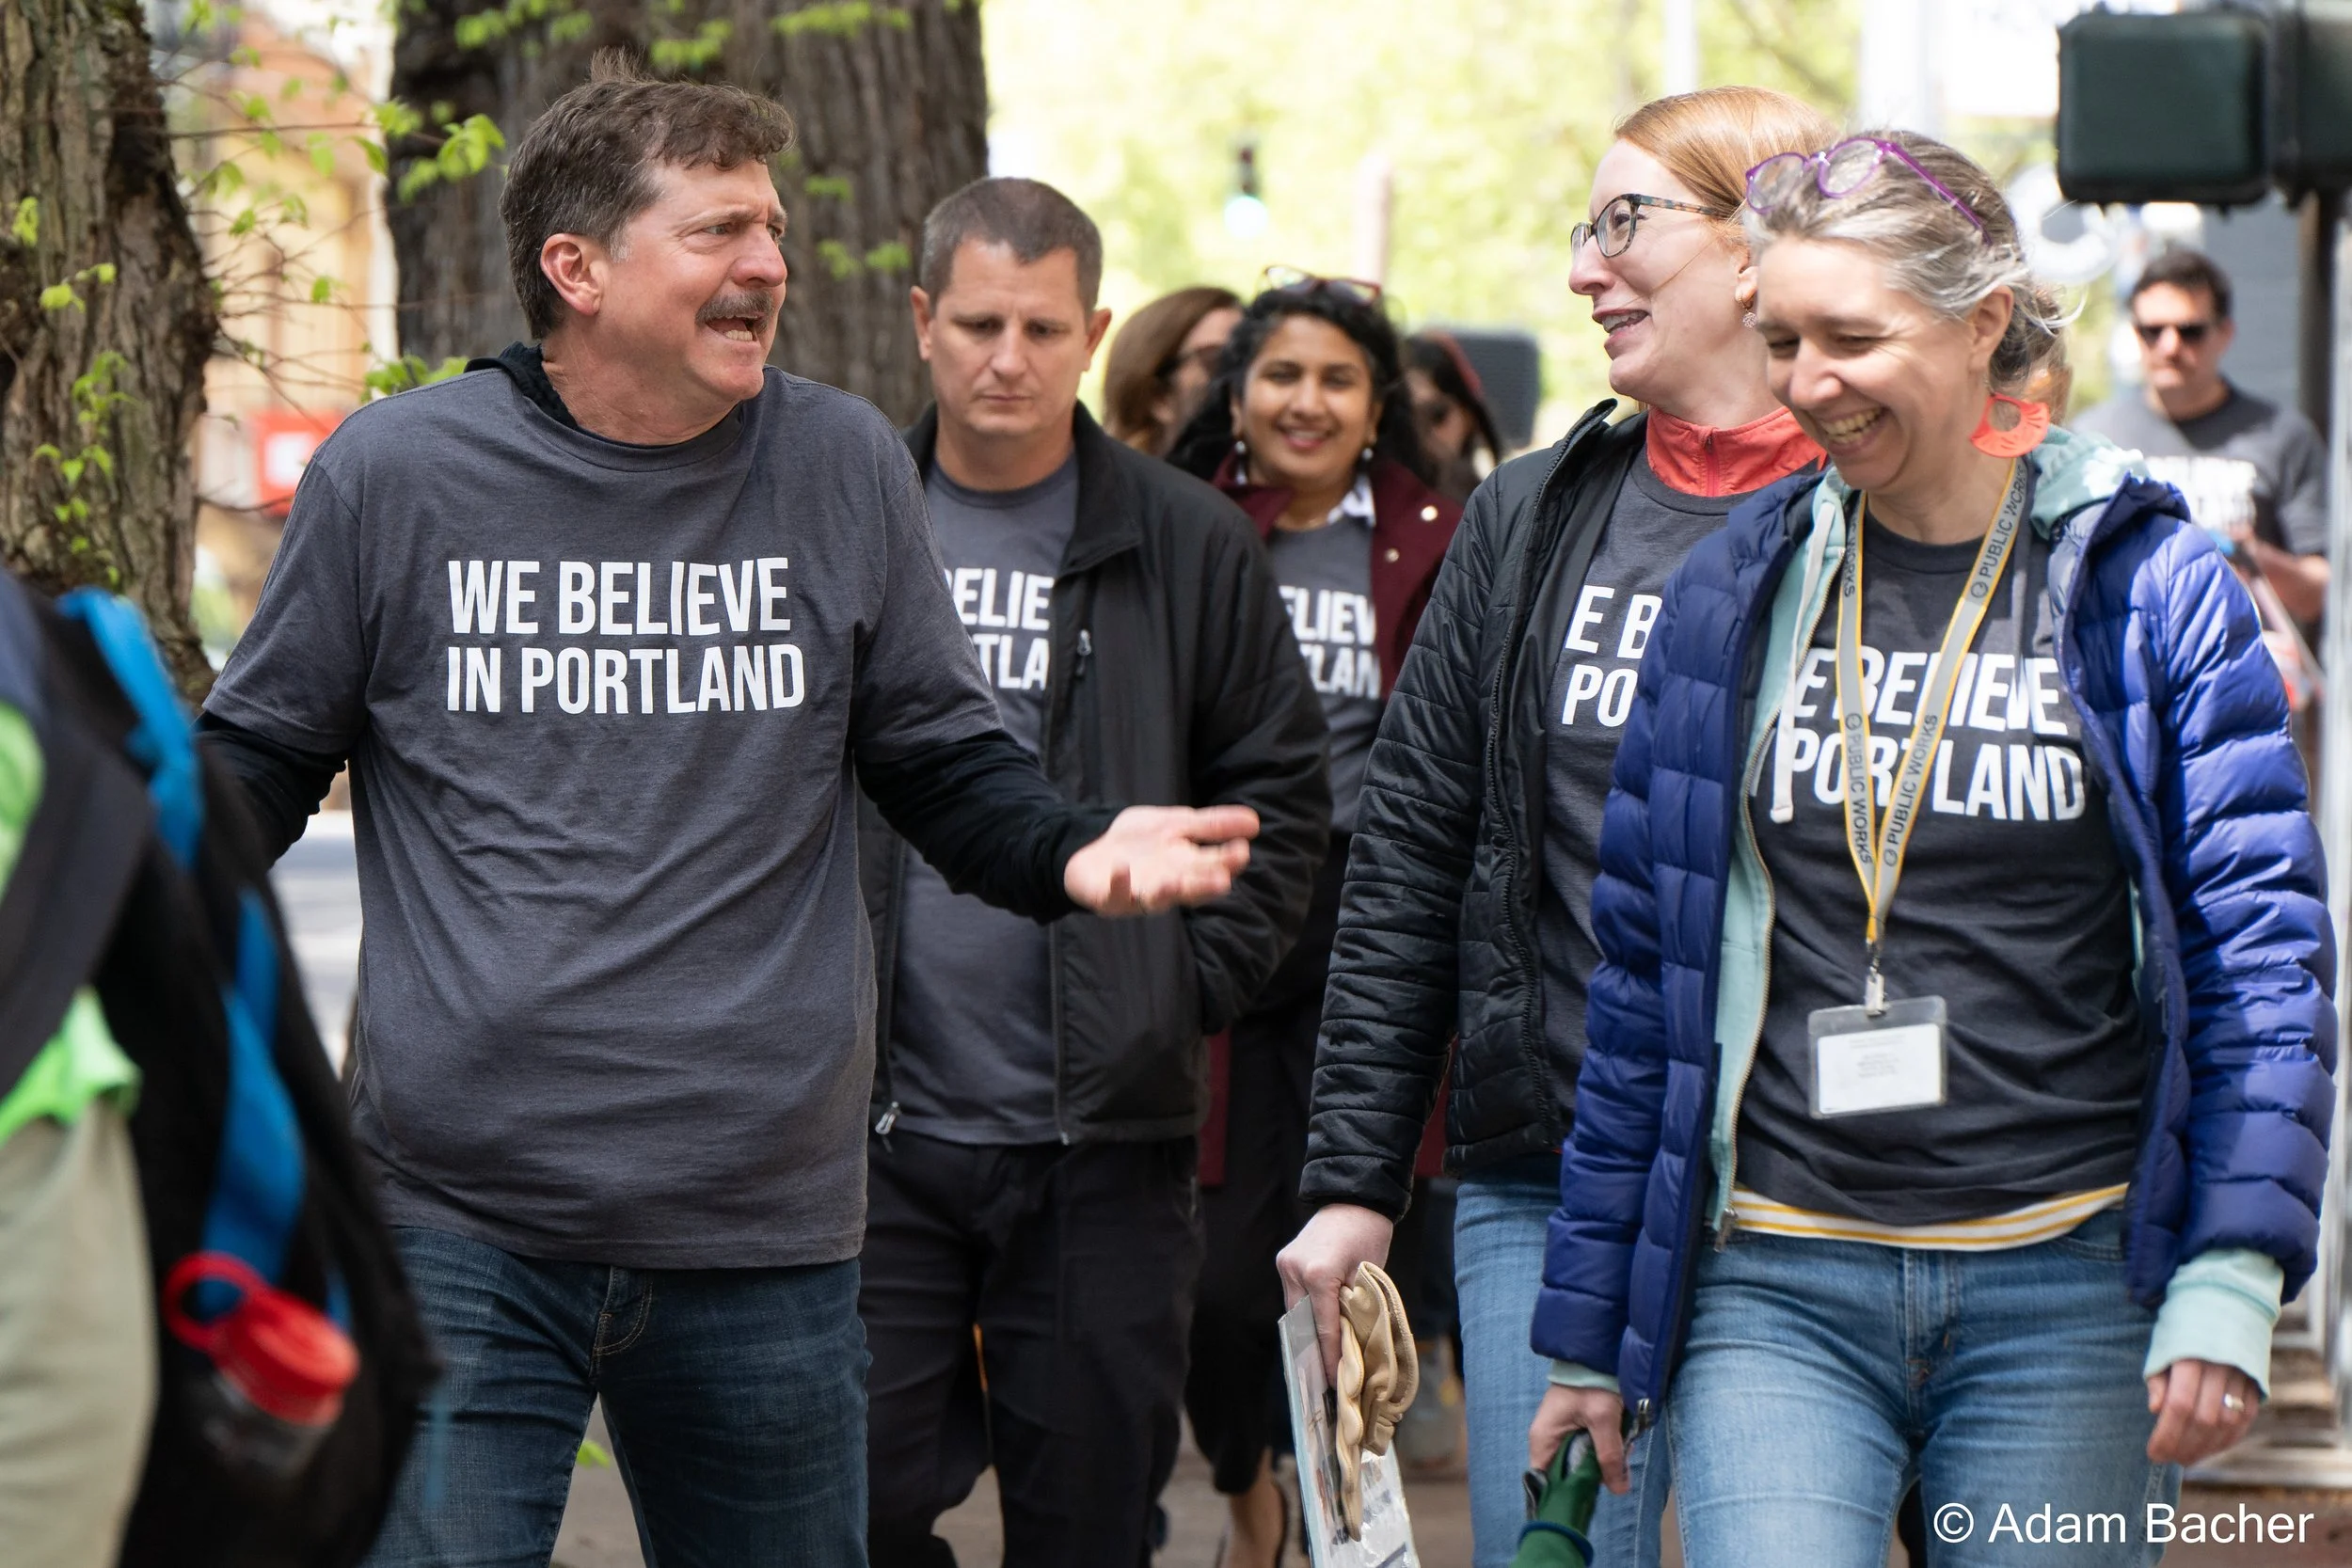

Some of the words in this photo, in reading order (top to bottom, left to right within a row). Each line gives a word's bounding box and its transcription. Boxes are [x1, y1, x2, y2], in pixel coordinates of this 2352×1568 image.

[1979, 518, 2013, 578] PUBLIC
[448, 560, 540, 634] WE
[559, 557, 792, 636] BELIEVE
[944, 567, 1055, 630] ELIE
[447, 646, 501, 713] IN
[521, 643, 805, 714] PORTLAND
[1299, 643, 1381, 700] LAN
[1792, 727, 2086, 821] PORLAND
[1847, 735, 1866, 792] PUBLIC
[1887, 781, 1917, 845] PUBLIC
[1908, 714, 1939, 779] WORKS
[1851, 798, 1873, 864] WORKS
